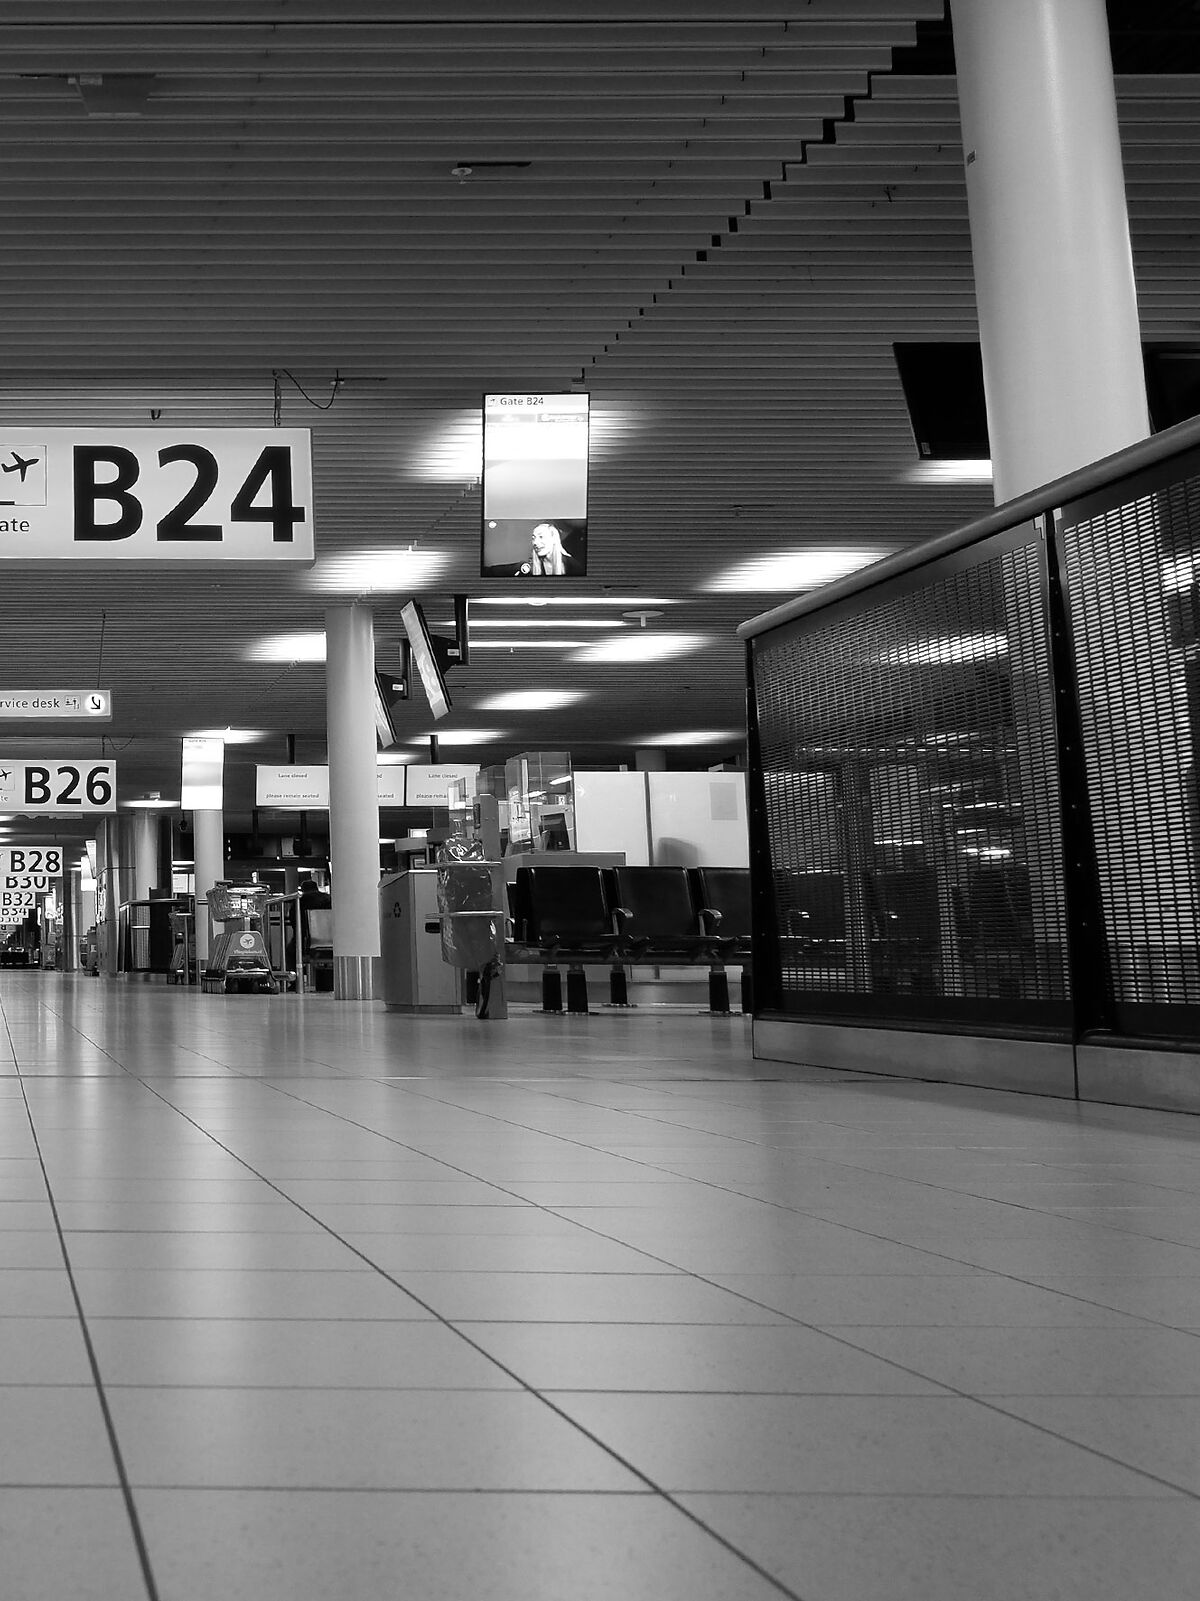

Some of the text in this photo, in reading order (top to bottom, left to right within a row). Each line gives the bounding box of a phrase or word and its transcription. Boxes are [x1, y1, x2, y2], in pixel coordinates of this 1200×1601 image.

[500, 397, 544, 406] Gate B24
[73, 443, 306, 542] B24
[32, 698, 60, 709] desk
[25, 765, 112, 805] B26
[10, 850, 60, 873] B28
[5, 877, 47, 889] B30
[2, 892, 33, 906] B32
